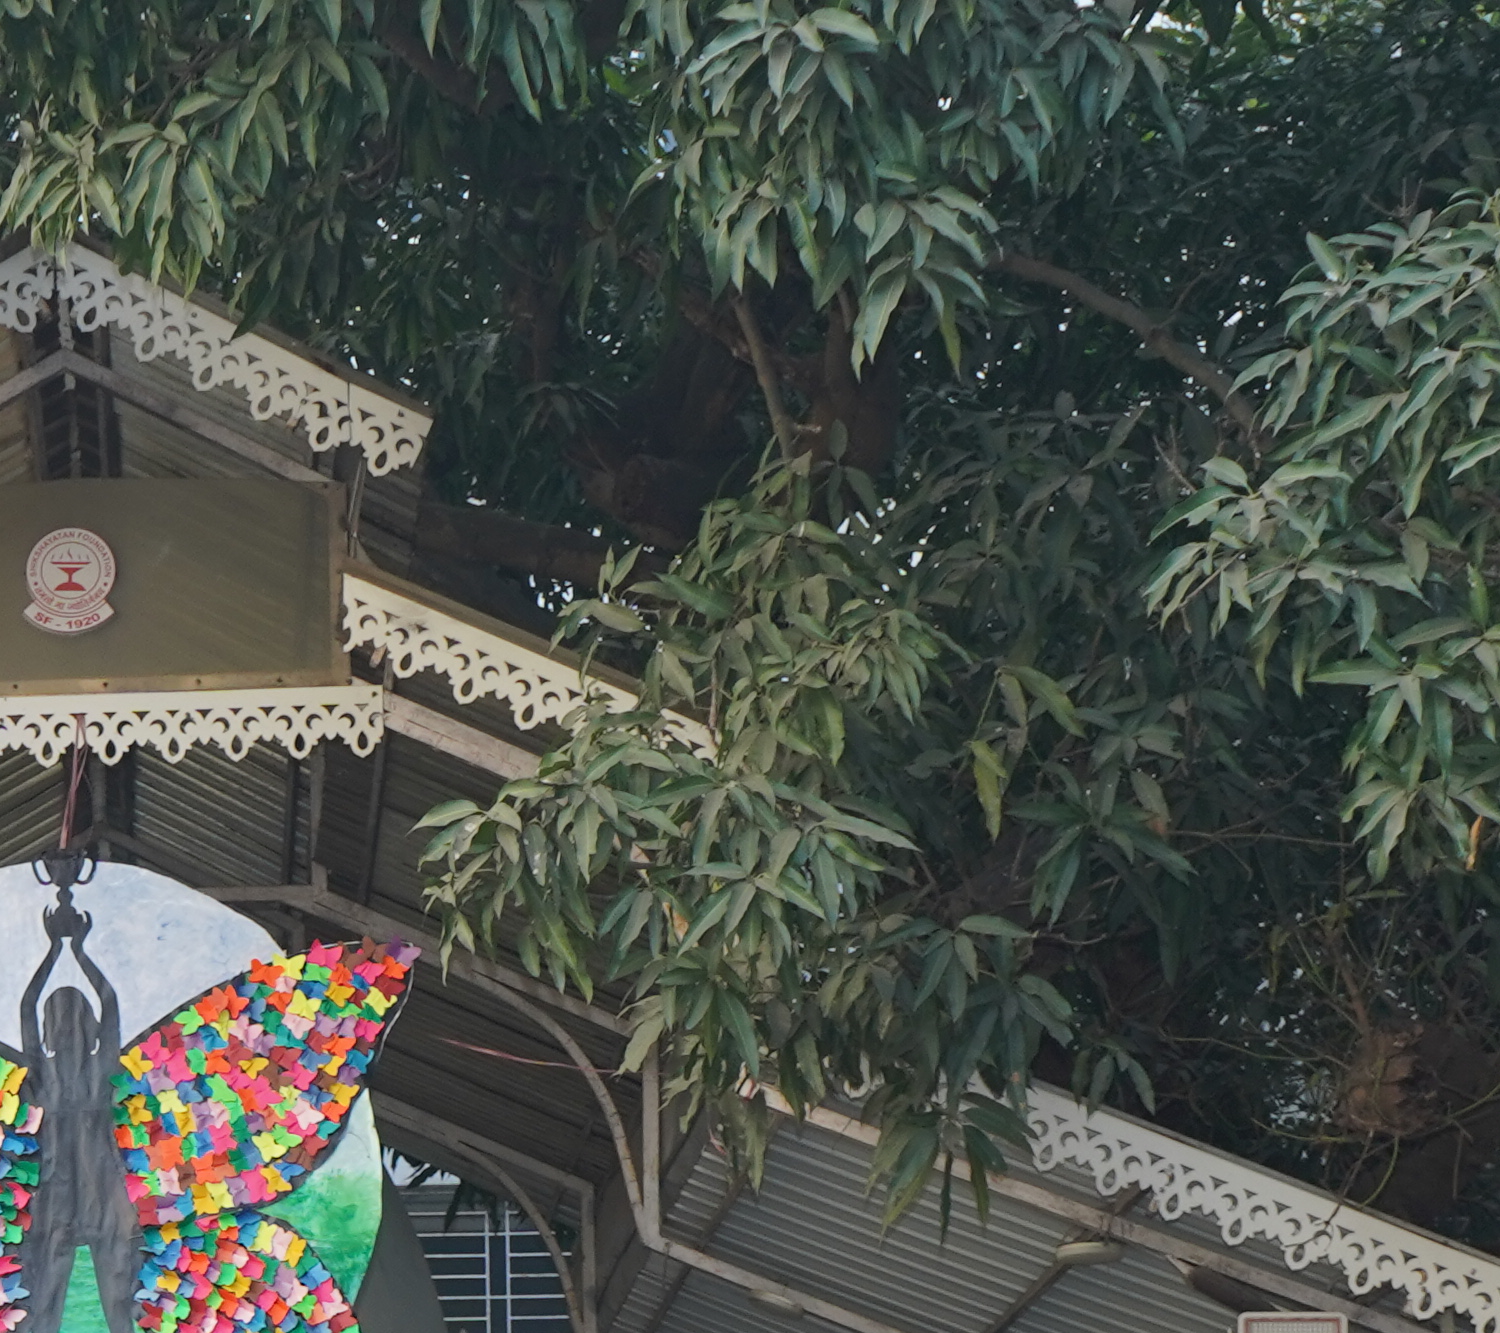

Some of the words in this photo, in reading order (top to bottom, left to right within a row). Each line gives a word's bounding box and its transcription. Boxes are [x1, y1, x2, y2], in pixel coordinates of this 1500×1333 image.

[76, 531, 112, 578] FOUNDATION
[34, 612, 53, 624] SF
[66, 613, 100, 629] 1920
